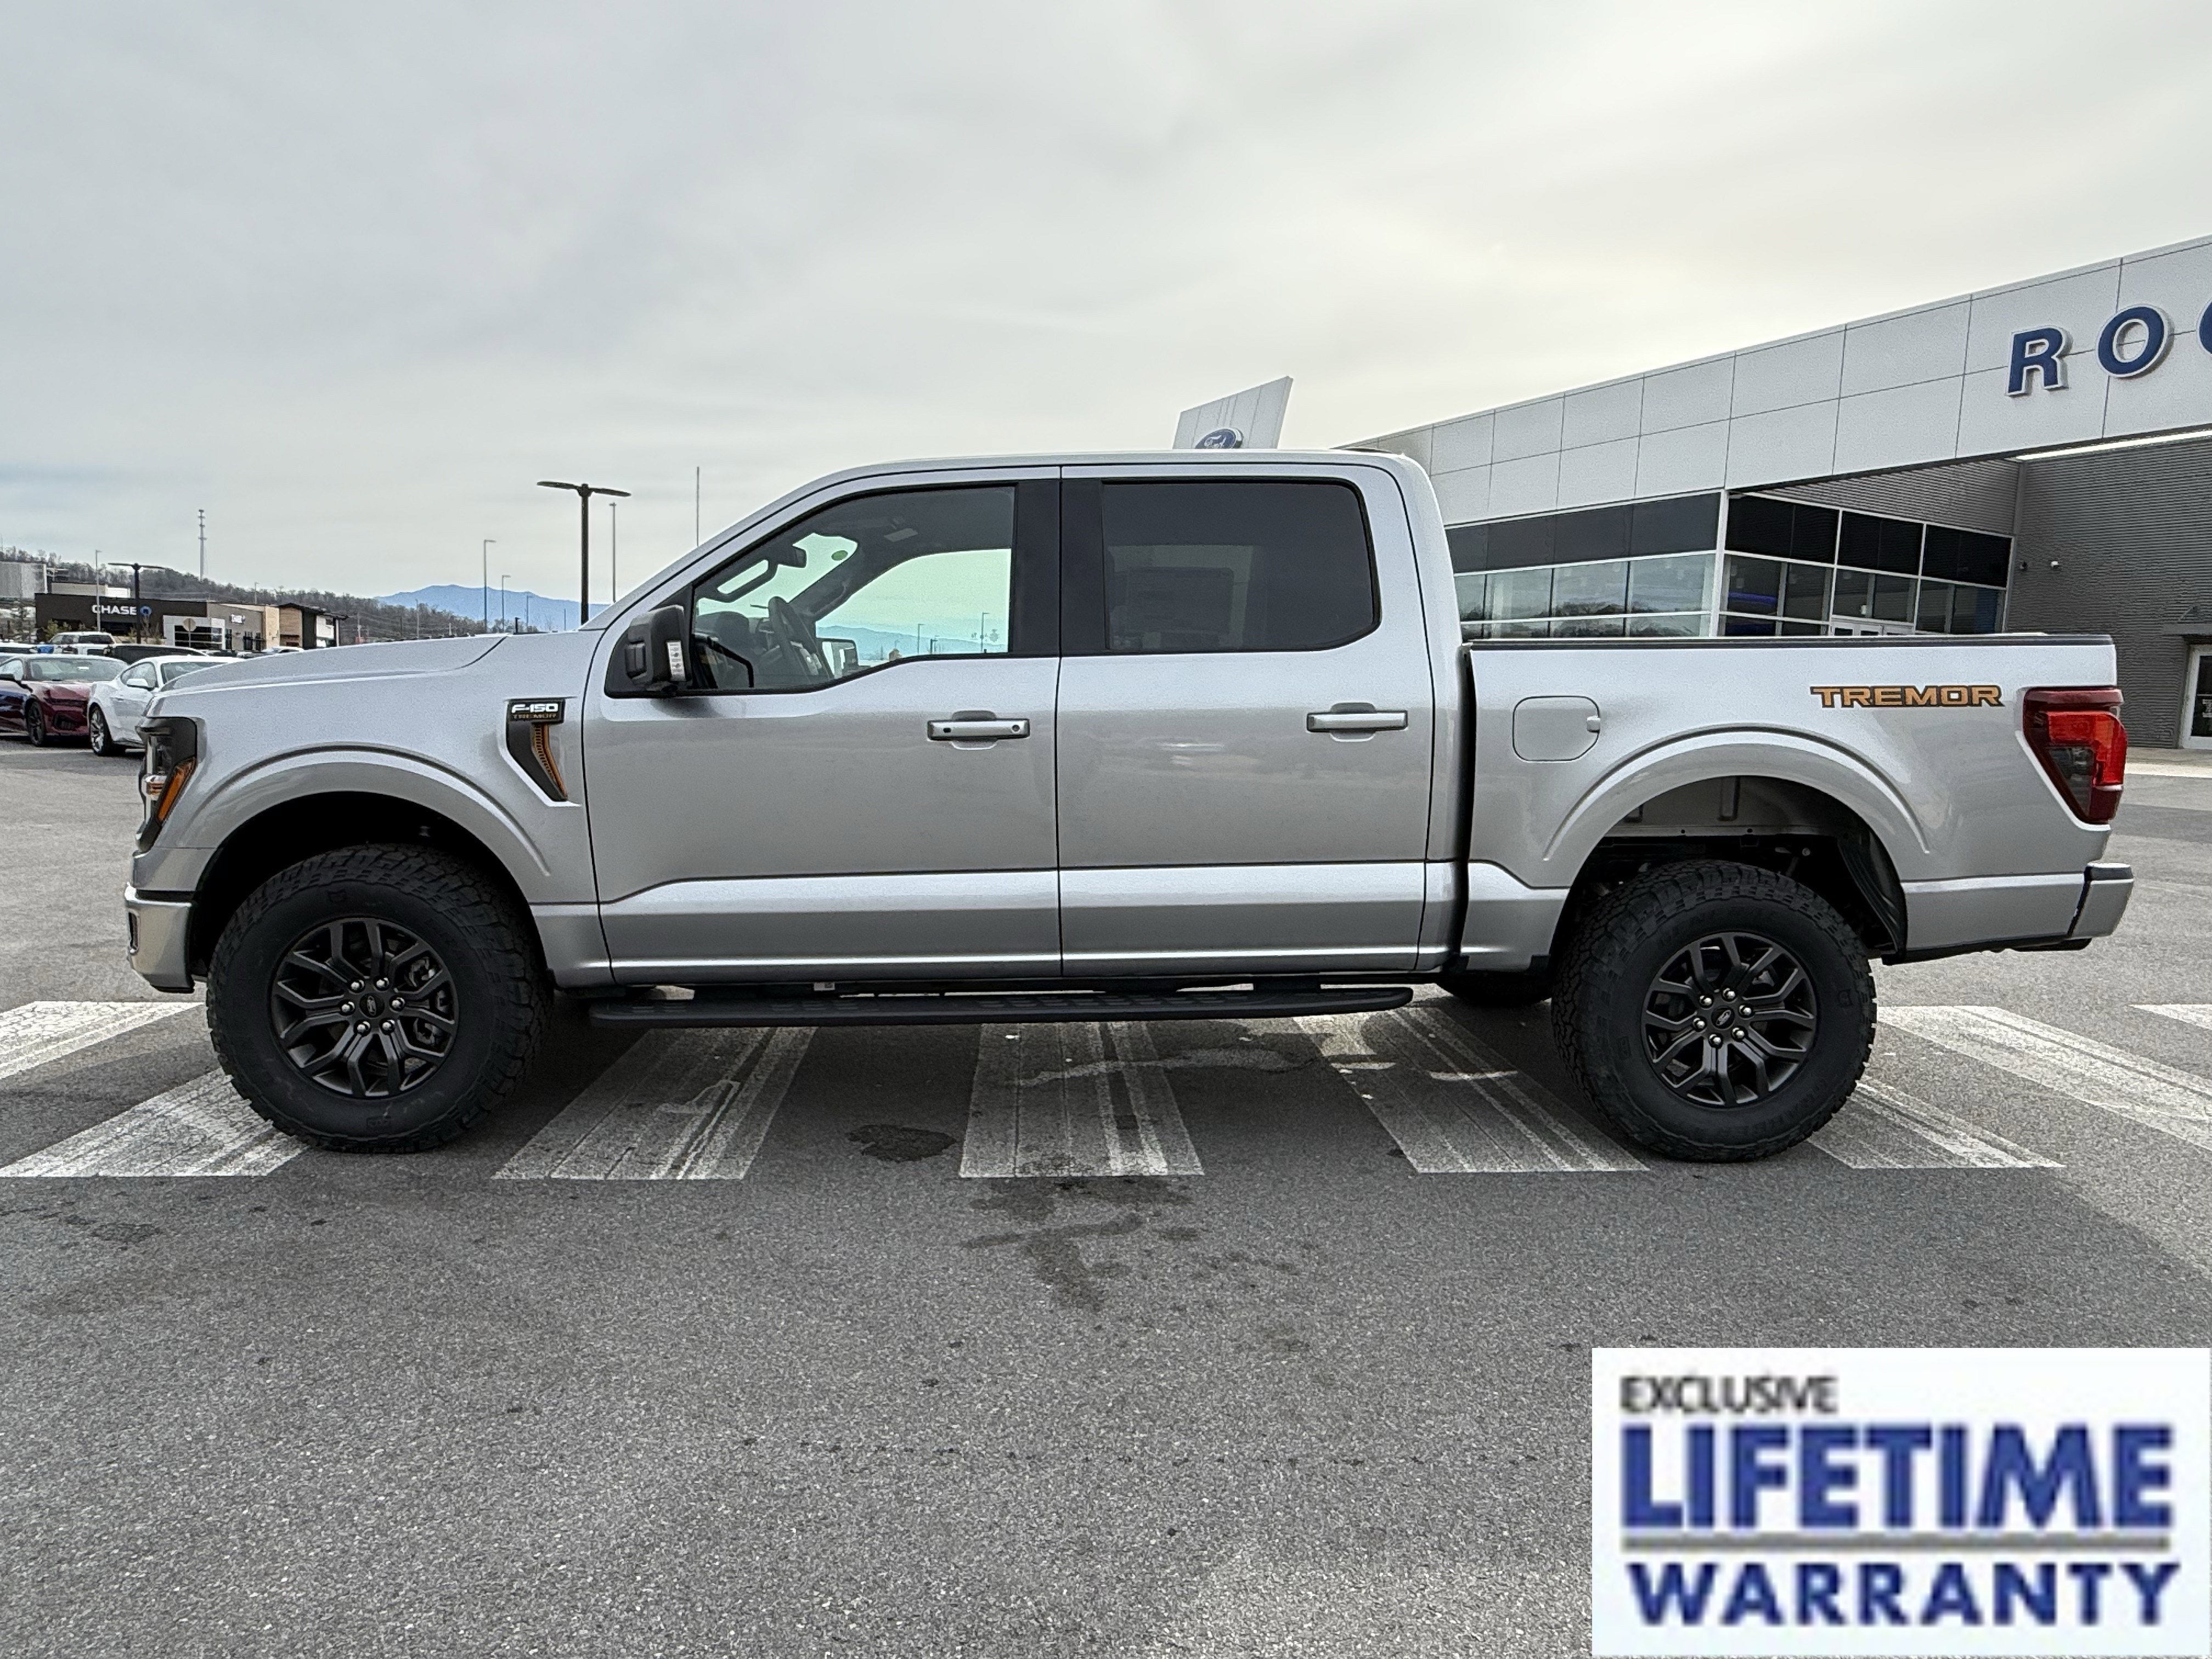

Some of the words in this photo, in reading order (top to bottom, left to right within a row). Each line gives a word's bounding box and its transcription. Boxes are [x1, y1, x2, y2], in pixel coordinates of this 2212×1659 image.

[2006, 297, 2212, 396] RO
[92, 605, 137, 615] CHASE
[1810, 685, 2005, 708] TREMOR
[511, 703, 558, 713] F-150
